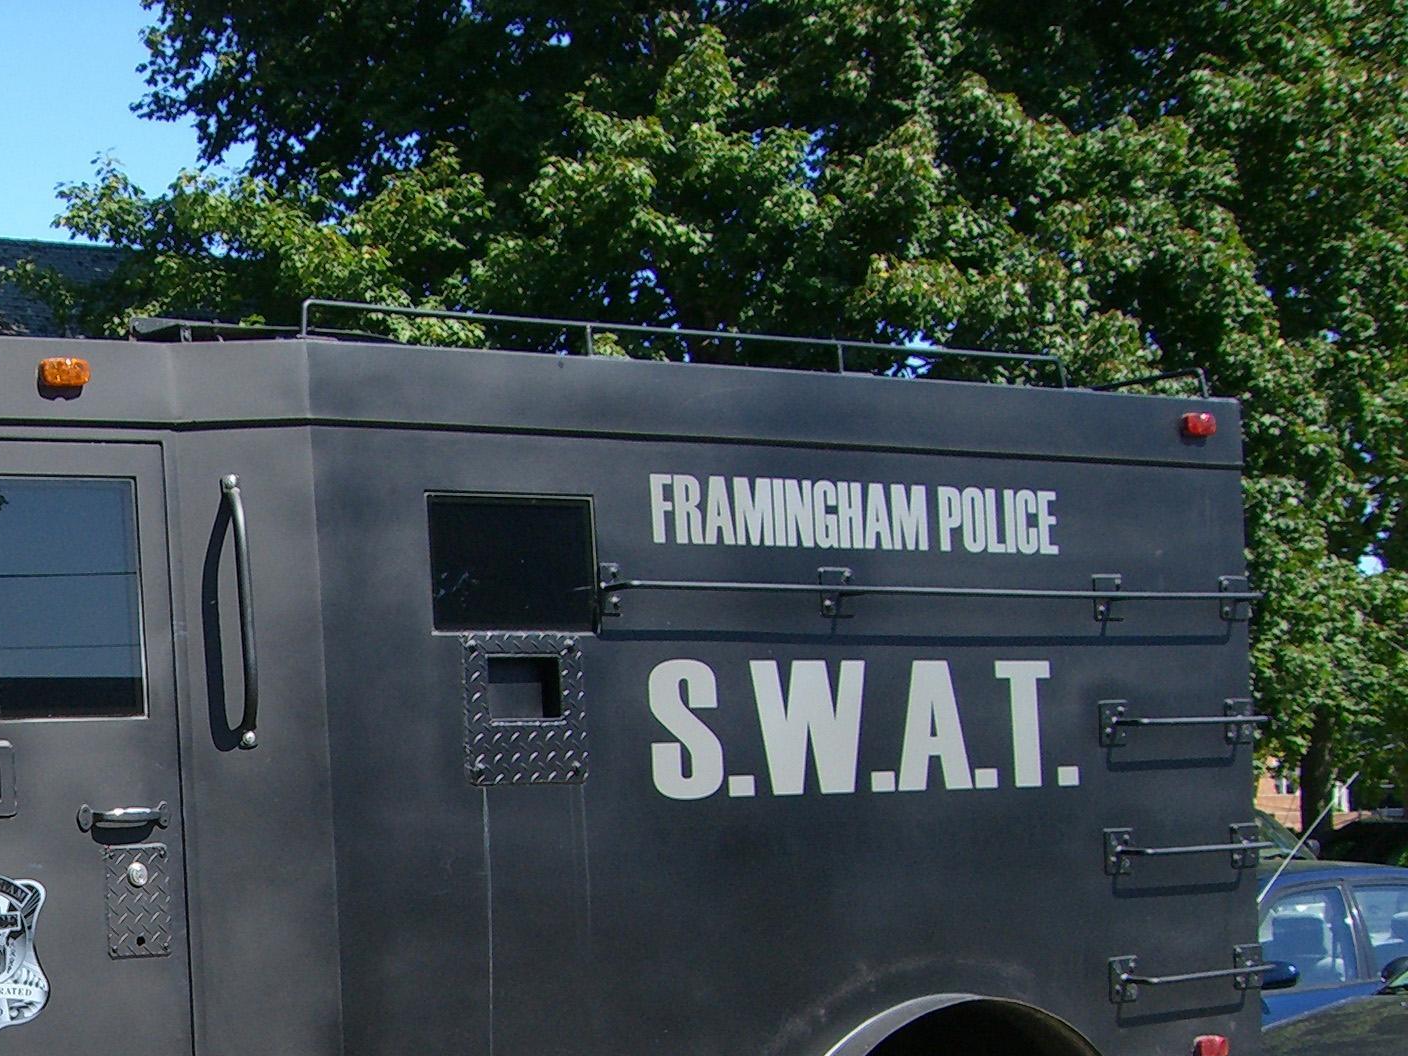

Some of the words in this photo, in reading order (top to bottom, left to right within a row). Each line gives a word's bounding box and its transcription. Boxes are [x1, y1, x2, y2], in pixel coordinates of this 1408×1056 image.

[649, 473, 930, 552] FRAMINGHAM
[937, 485, 1060, 555] POLICE
[648, 659, 1080, 800] S.W.A.T.
